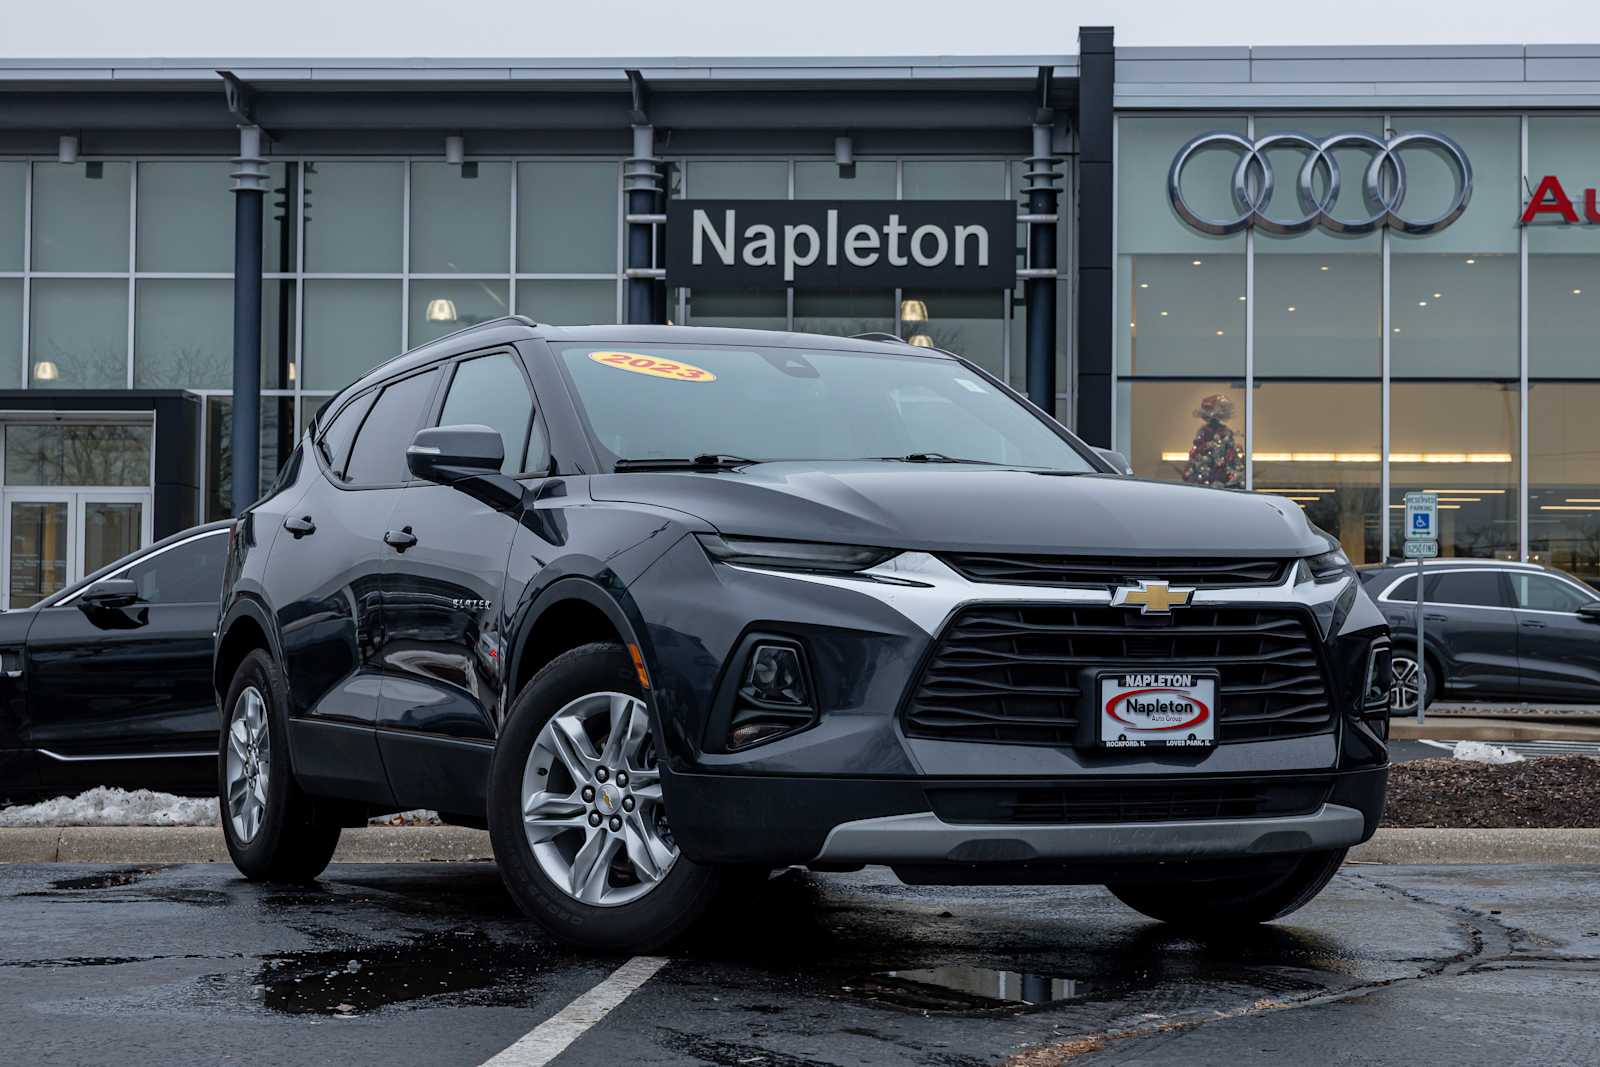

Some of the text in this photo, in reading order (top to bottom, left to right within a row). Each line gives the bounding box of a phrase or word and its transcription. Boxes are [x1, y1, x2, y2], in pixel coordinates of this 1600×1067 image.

[691, 209, 990, 282] Napleton
[600, 354, 705, 379] 2023
[1406, 496, 1435, 504] RESERVED
[1409, 504, 1433, 512] PARKING
[452, 599, 492, 610] BLAZER
[1125, 674, 1192, 687] NAPLETON
[1126, 698, 1193, 717] Napleton
[1151, 714, 1183, 723] Auto Group
